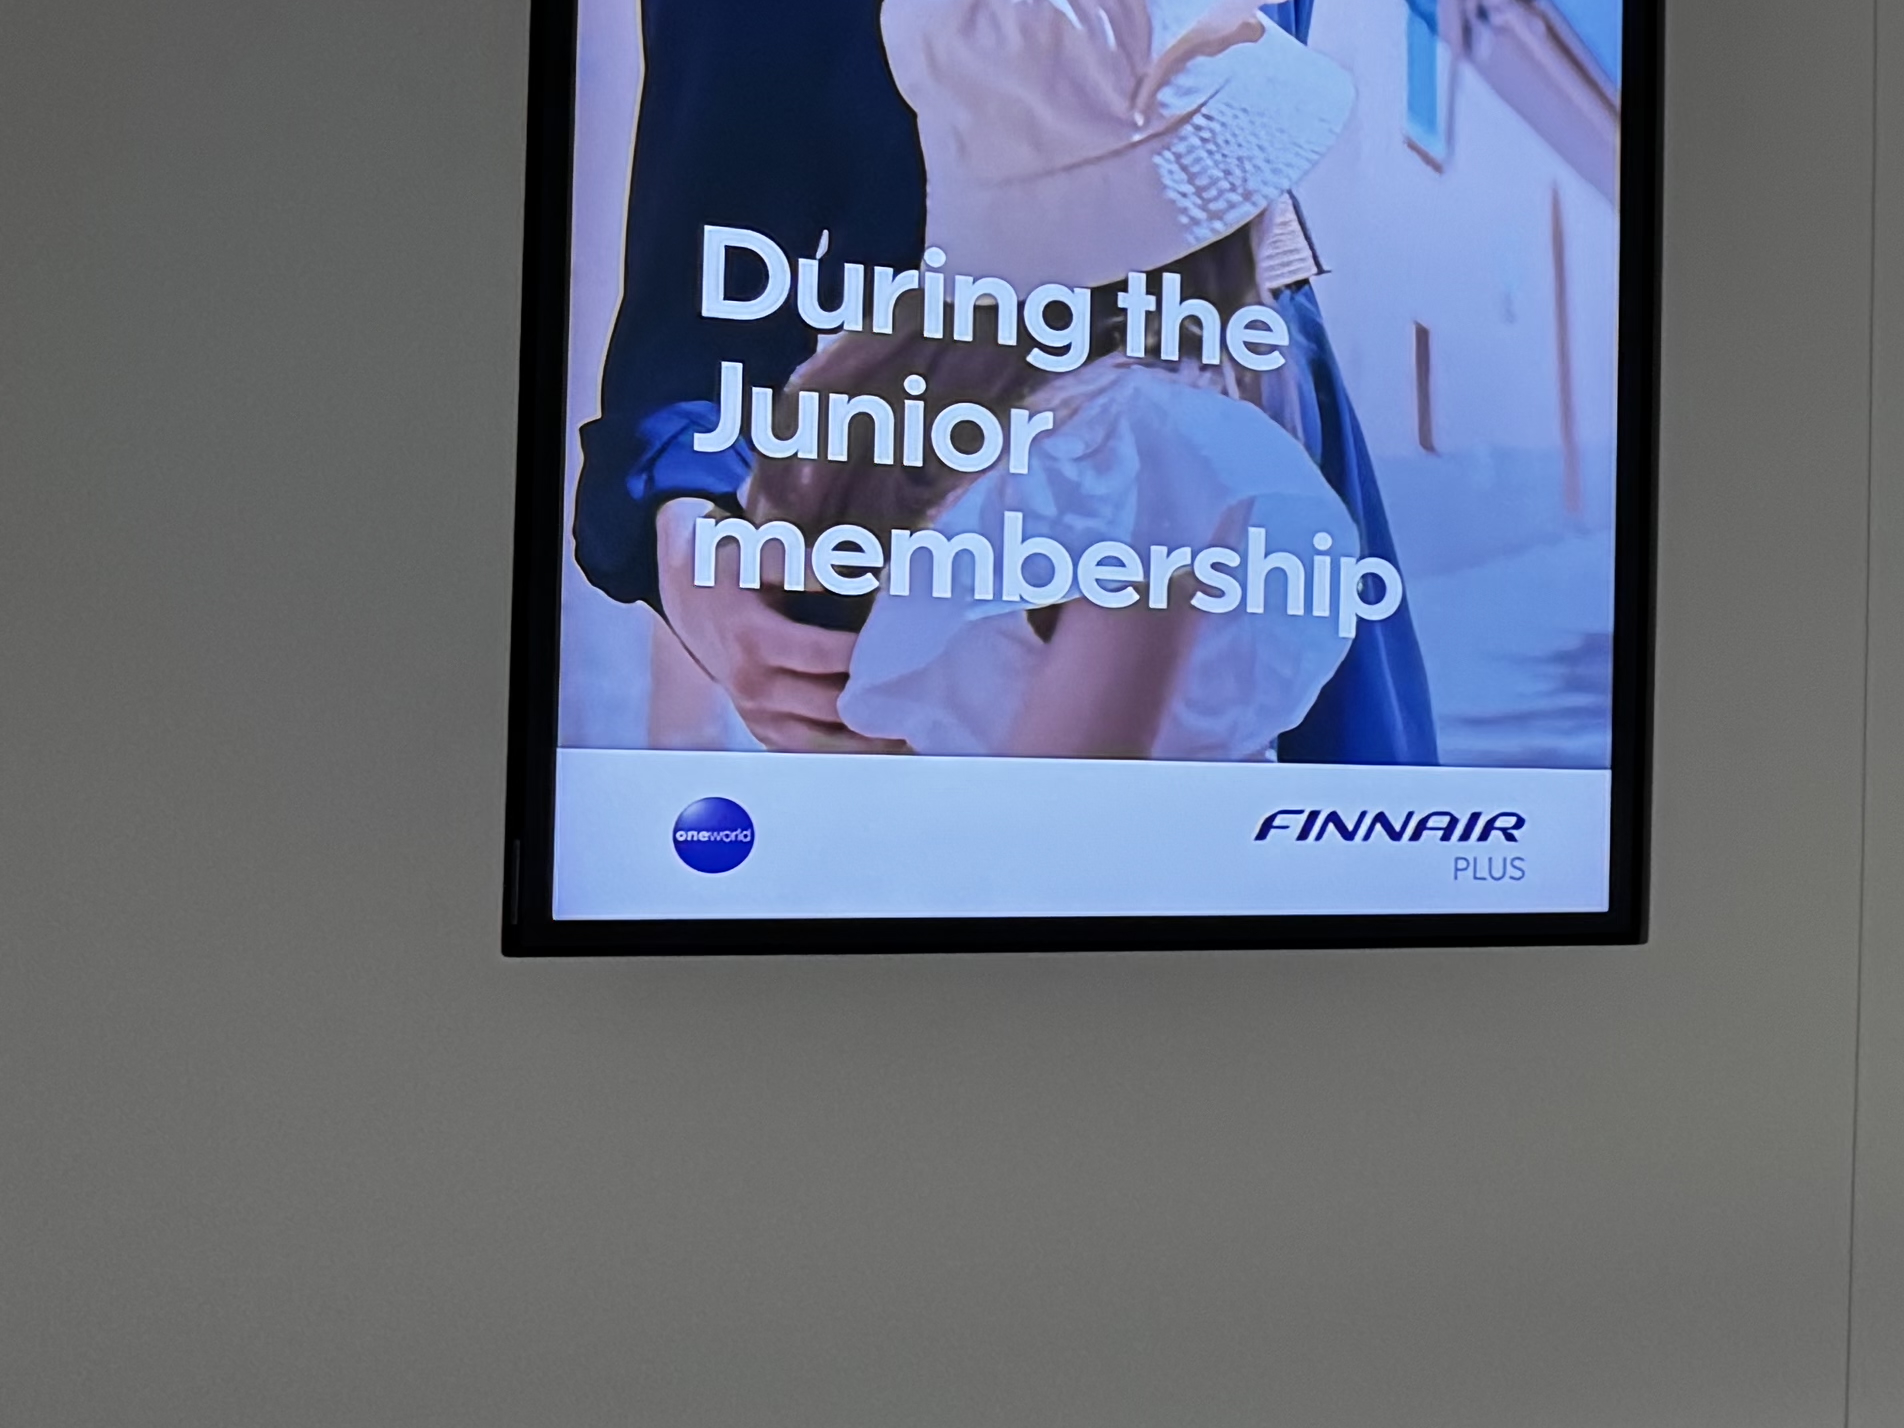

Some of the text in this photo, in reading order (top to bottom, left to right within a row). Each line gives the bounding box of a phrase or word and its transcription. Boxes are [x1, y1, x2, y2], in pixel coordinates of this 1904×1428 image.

[701, 225, 1290, 372] During the
[693, 361, 1054, 474] Junior
[693, 511, 1403, 639] membership
[675, 827, 752, 843] oneworld
[1253, 808, 1526, 843] FINNAIR
[1453, 856, 1526, 881] PLUS
